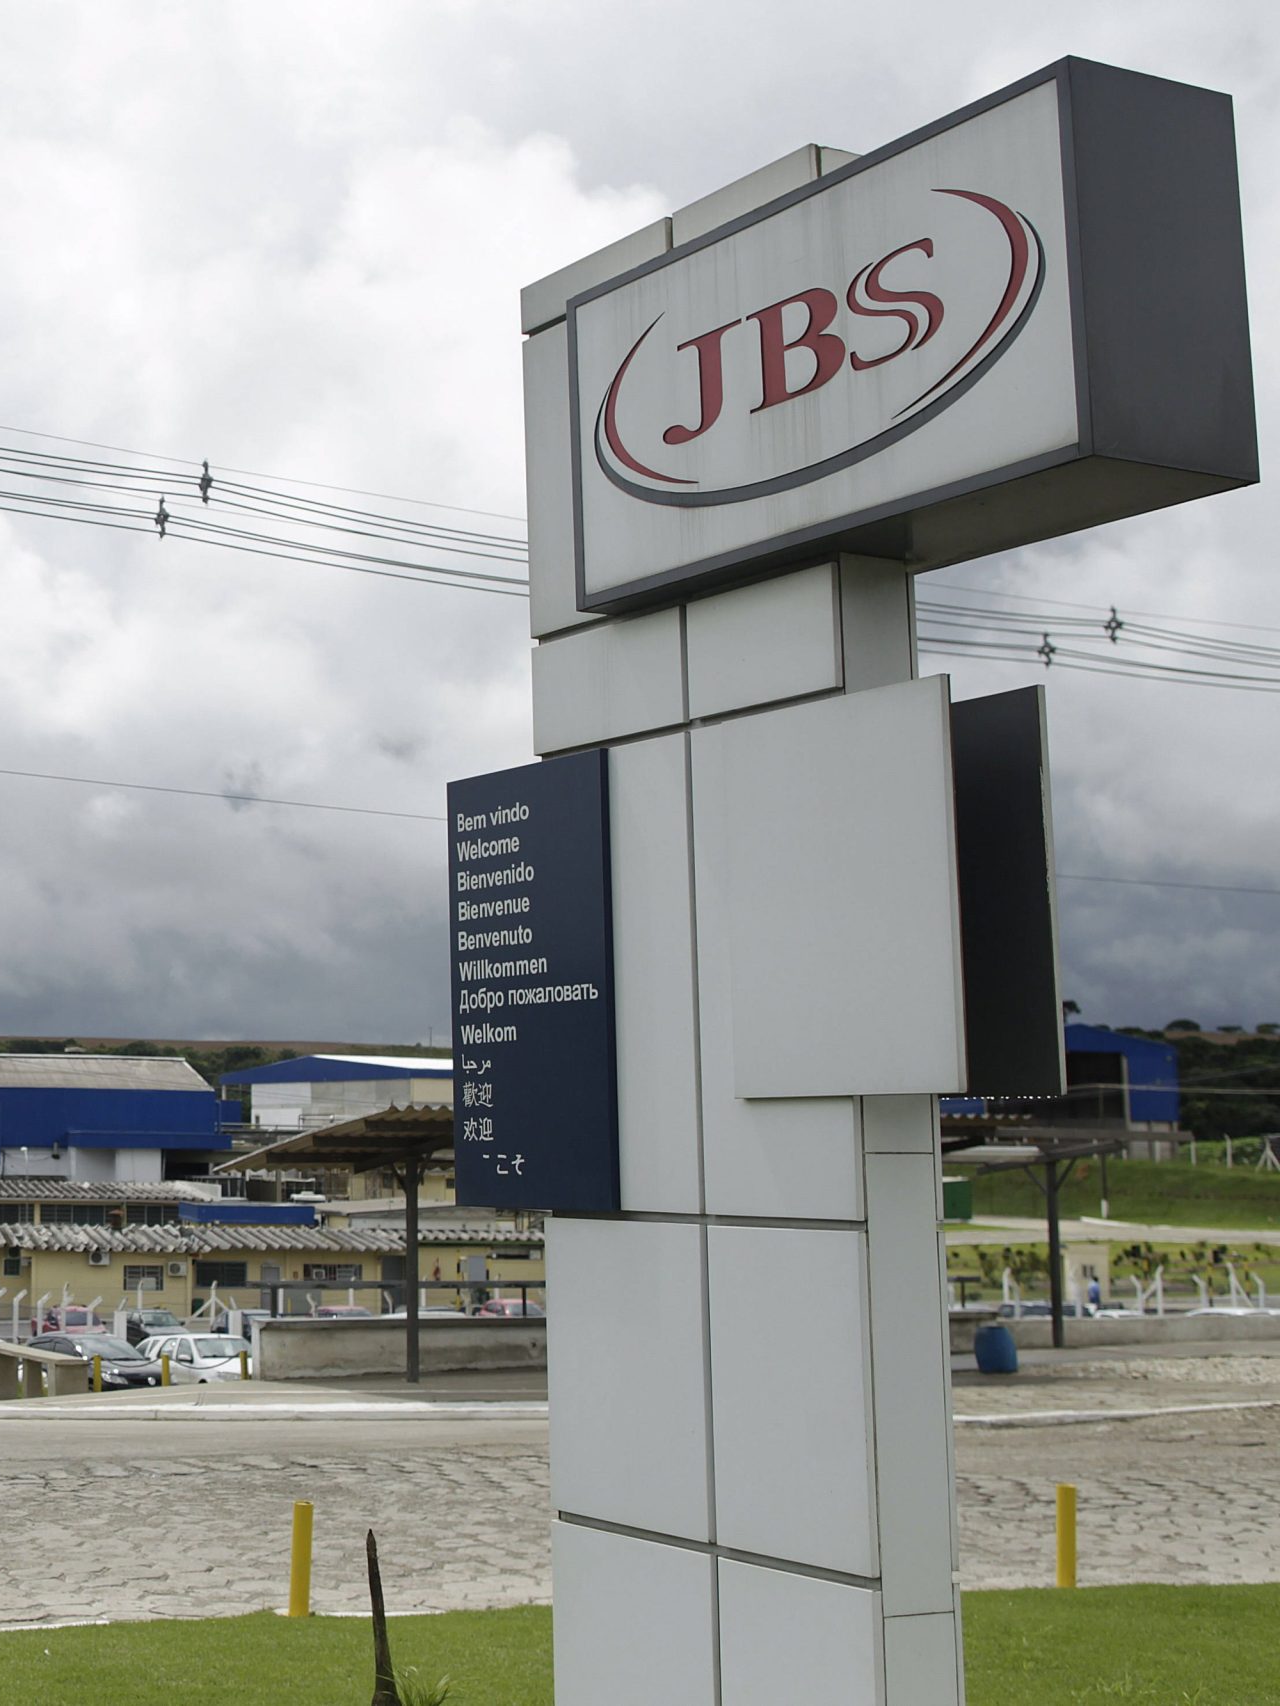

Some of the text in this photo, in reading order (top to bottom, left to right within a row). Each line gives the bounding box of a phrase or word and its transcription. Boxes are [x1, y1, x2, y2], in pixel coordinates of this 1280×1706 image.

[663, 238, 944, 445] JBS
[457, 802, 529, 832] Bem vindo
[457, 836, 520, 862] Welcome
[457, 862, 534, 891] Bienvenido
[458, 897, 530, 921] Bienvenue
[458, 925, 532, 951] Benvenuto
[459, 957, 548, 981] Willkommen
[459, 983, 598, 1014] Добро пожаловать
[461, 1023, 517, 1044] Welkom
[461, 1054, 491, 1074] مرحبا
[462, 1081, 493, 1107] 歡迎
[463, 1117, 493, 1141] 欢迎
